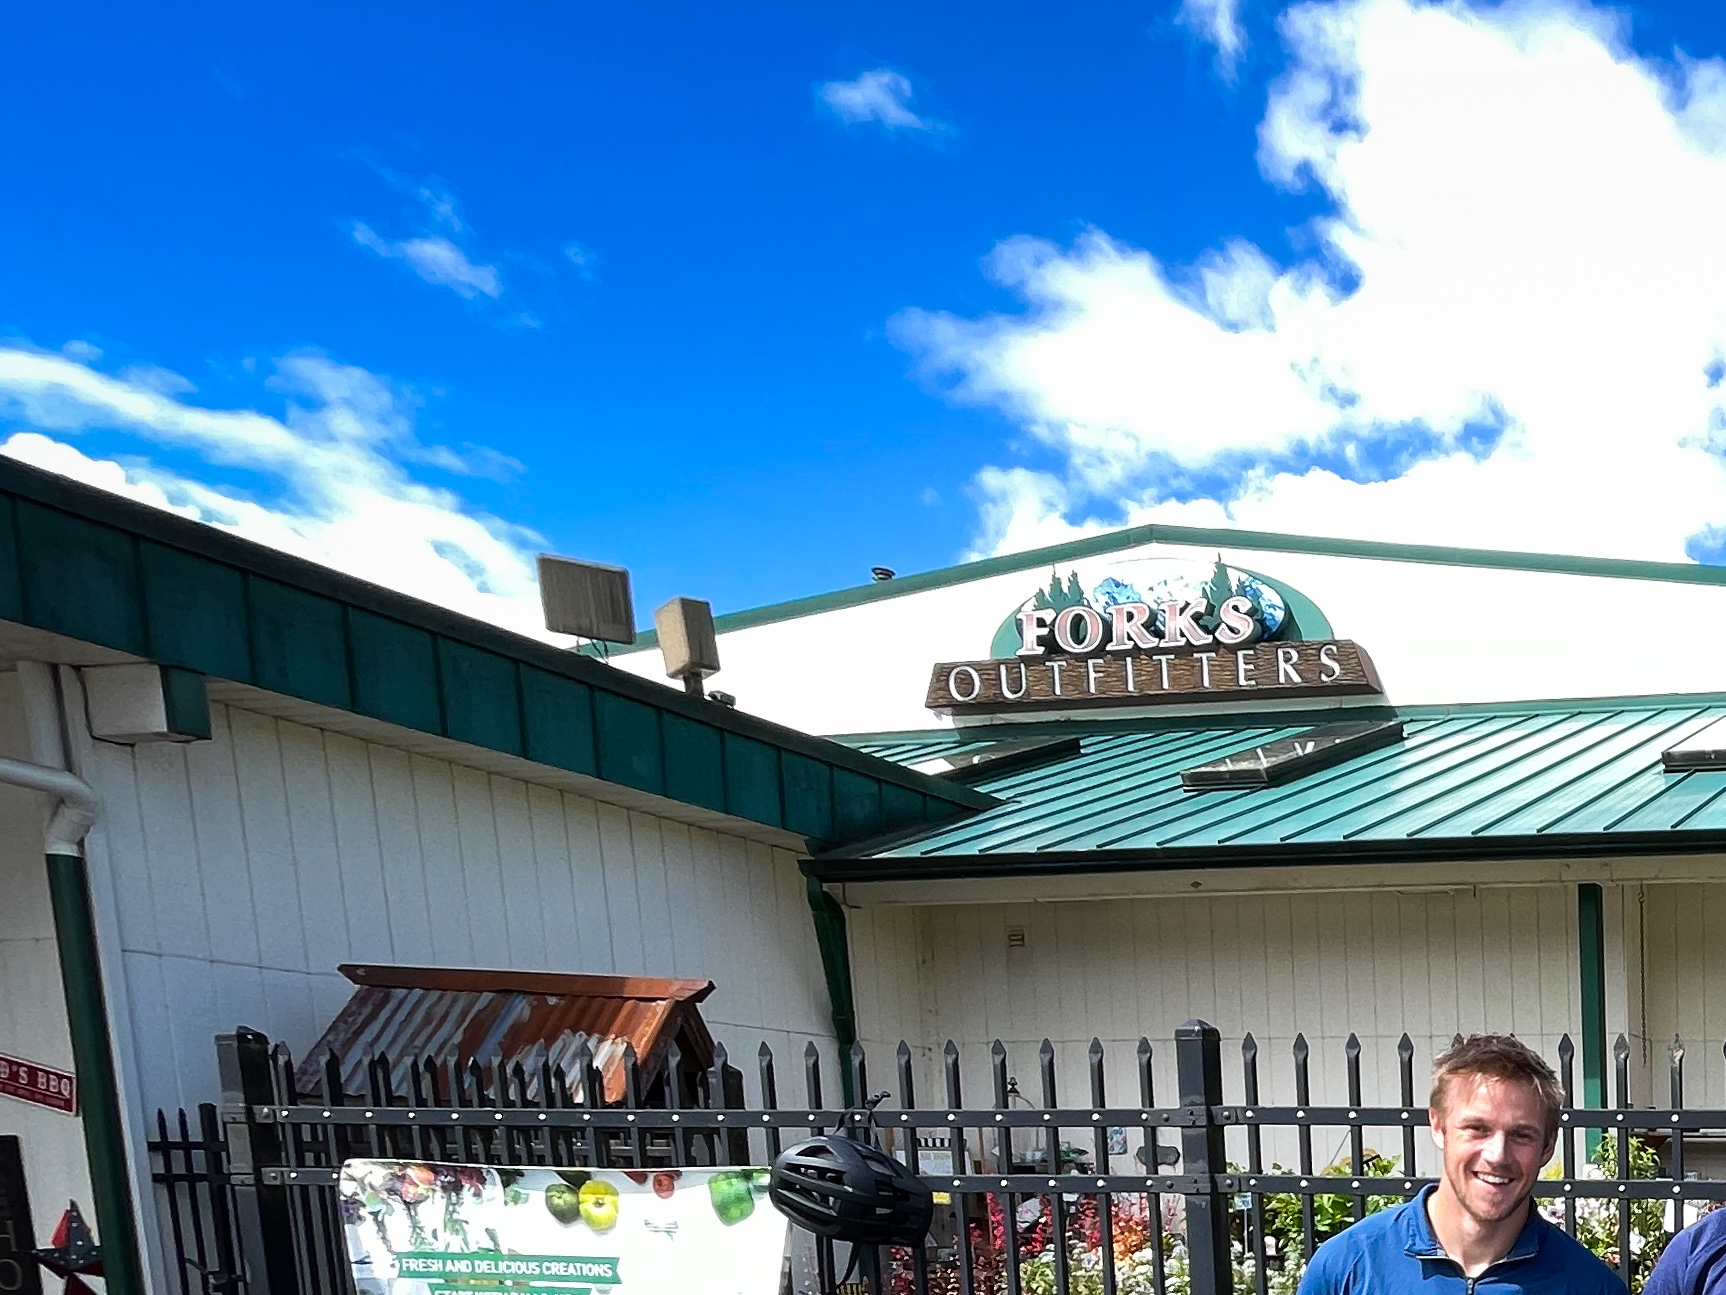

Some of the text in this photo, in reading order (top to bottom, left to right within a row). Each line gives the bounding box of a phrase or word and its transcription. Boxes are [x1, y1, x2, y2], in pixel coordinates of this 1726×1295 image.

[1016, 596, 1253, 657] FORKS
[948, 643, 1341, 703] OUTFITTERS
[37, 1070, 71, 1099] BBQ
[402, 1258, 613, 1278] FRESH AND DELICIOUS CREATIONS
